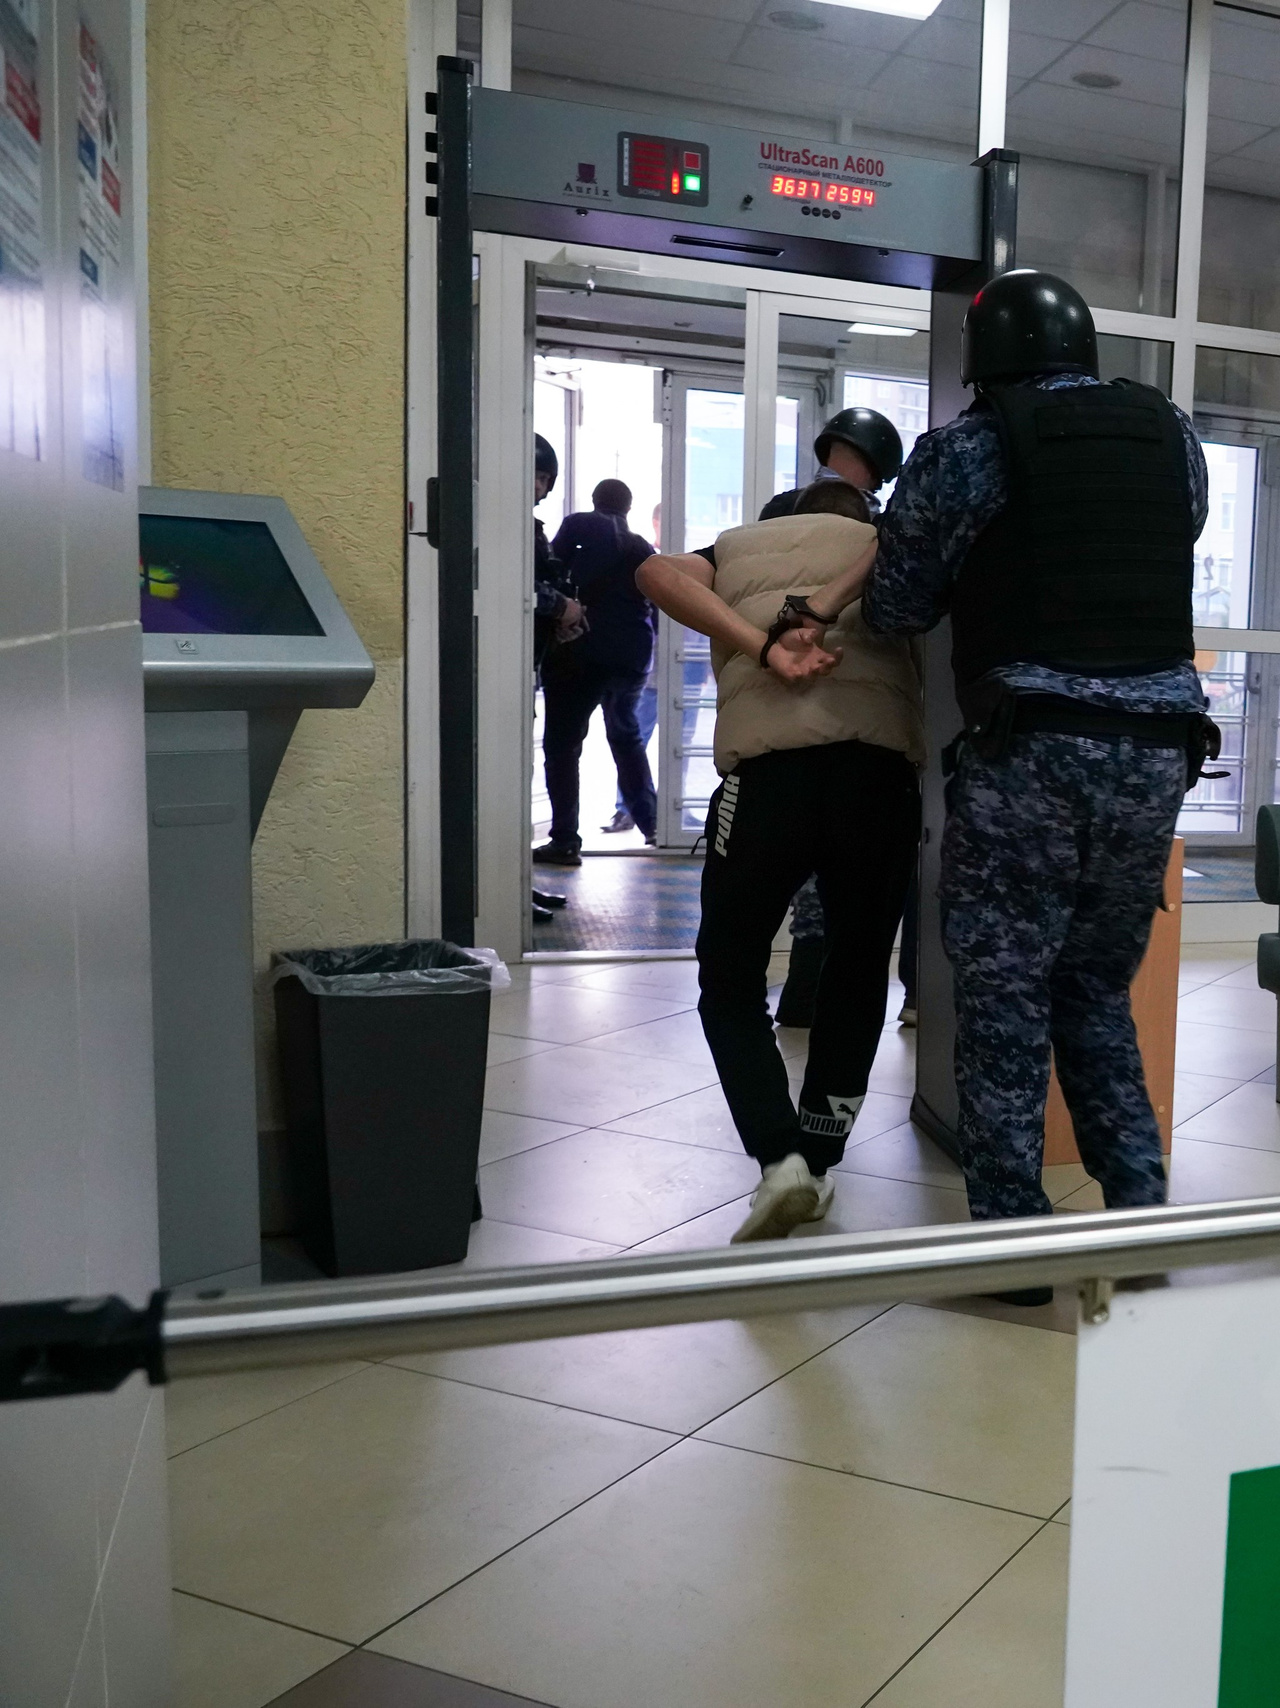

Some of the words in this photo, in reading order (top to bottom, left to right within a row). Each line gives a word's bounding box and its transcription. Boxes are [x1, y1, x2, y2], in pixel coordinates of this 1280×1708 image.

[760, 141, 838, 170] UltraScan
[843, 155, 884, 177] A600
[758, 162, 821, 179] СТАЦИОНАРНЫЙ
[821, 171, 892, 188] МЕТАЛЛОДЕТЕКТОР
[563, 182, 610, 197] Aurix
[772, 177, 821, 198] 3637
[826, 185, 874, 205] 2594
[715, 773, 740, 857] PUMA
[801, 1113, 847, 1134] PUMA
